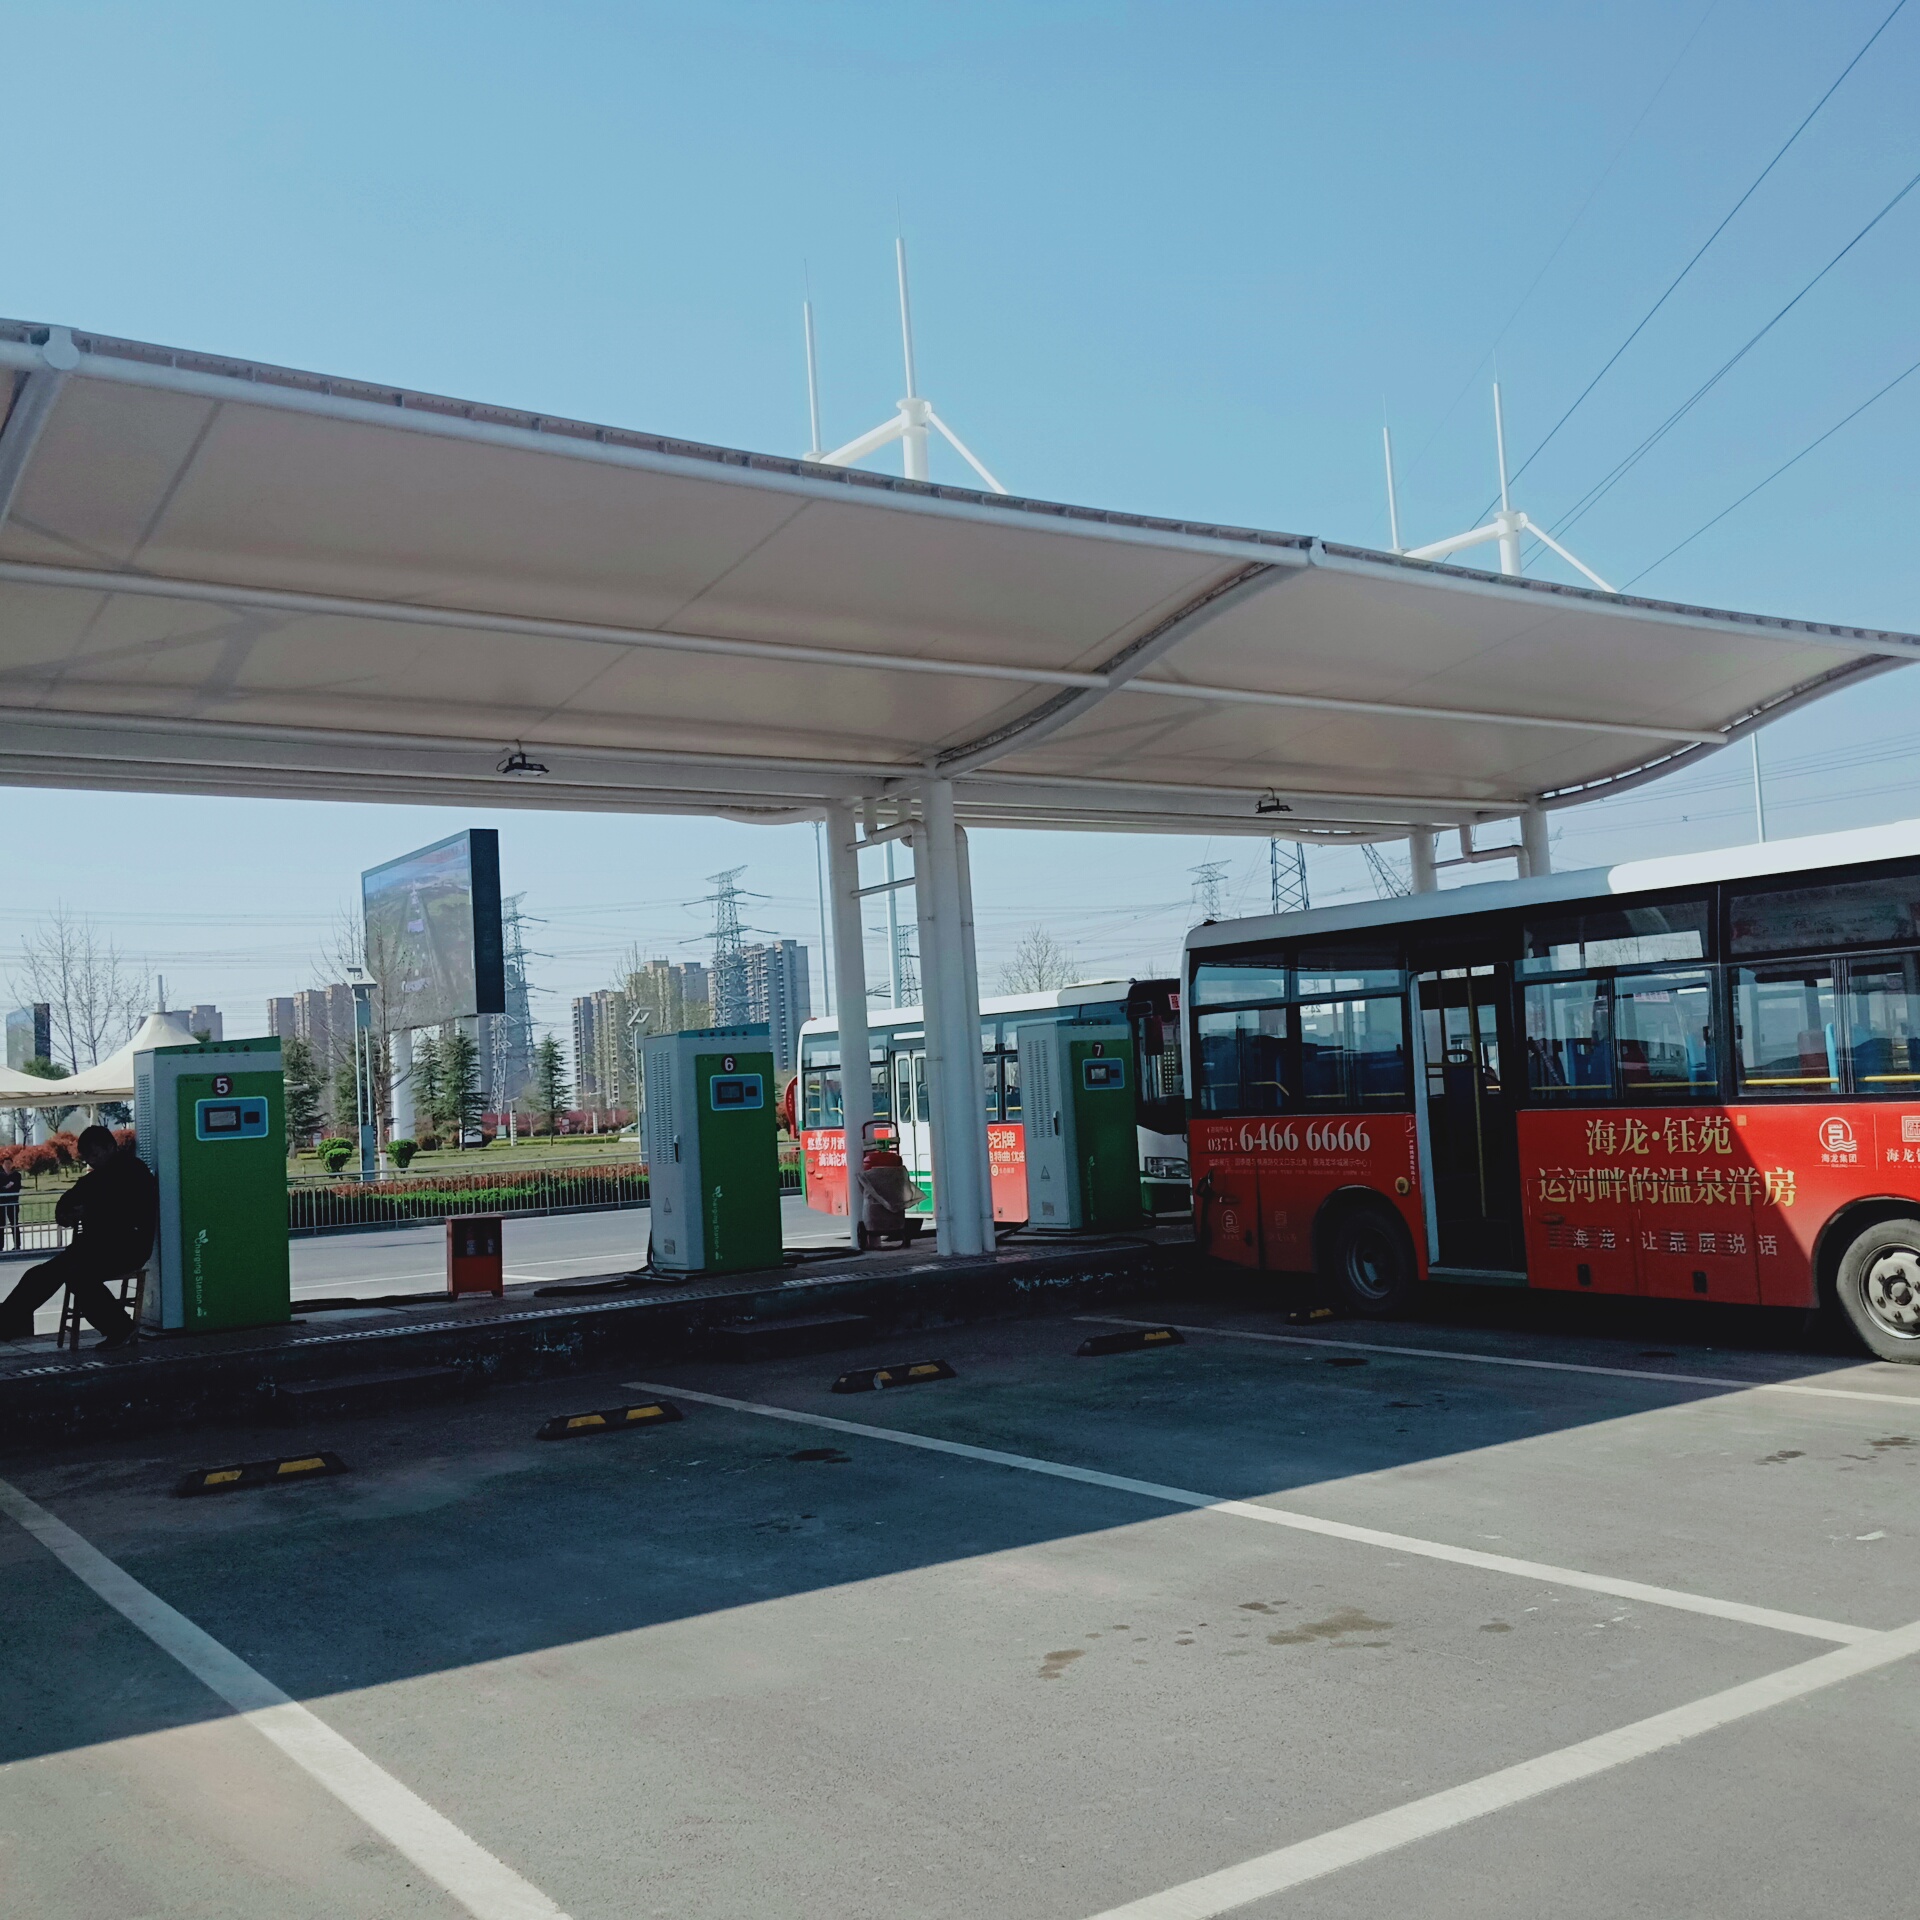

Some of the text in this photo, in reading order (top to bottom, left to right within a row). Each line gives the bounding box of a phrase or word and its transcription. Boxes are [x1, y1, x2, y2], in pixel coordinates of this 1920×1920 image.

[1095, 1044, 1102, 1057] 7
[724, 1057, 734, 1071] 6
[216, 1077, 229, 1094] 5
[1305, 1121, 1371, 1152] 6666
[1585, 1115, 1733, 1156] 海龙·钰苑
[1821, 1153, 1858, 1163] 海龙集团
[1886, 1148, 1920, 1163] 海龙
[1538, 1166, 1798, 1207] 运河畔的温泉洋房
[194, 1237, 203, 1304] Charging Station
